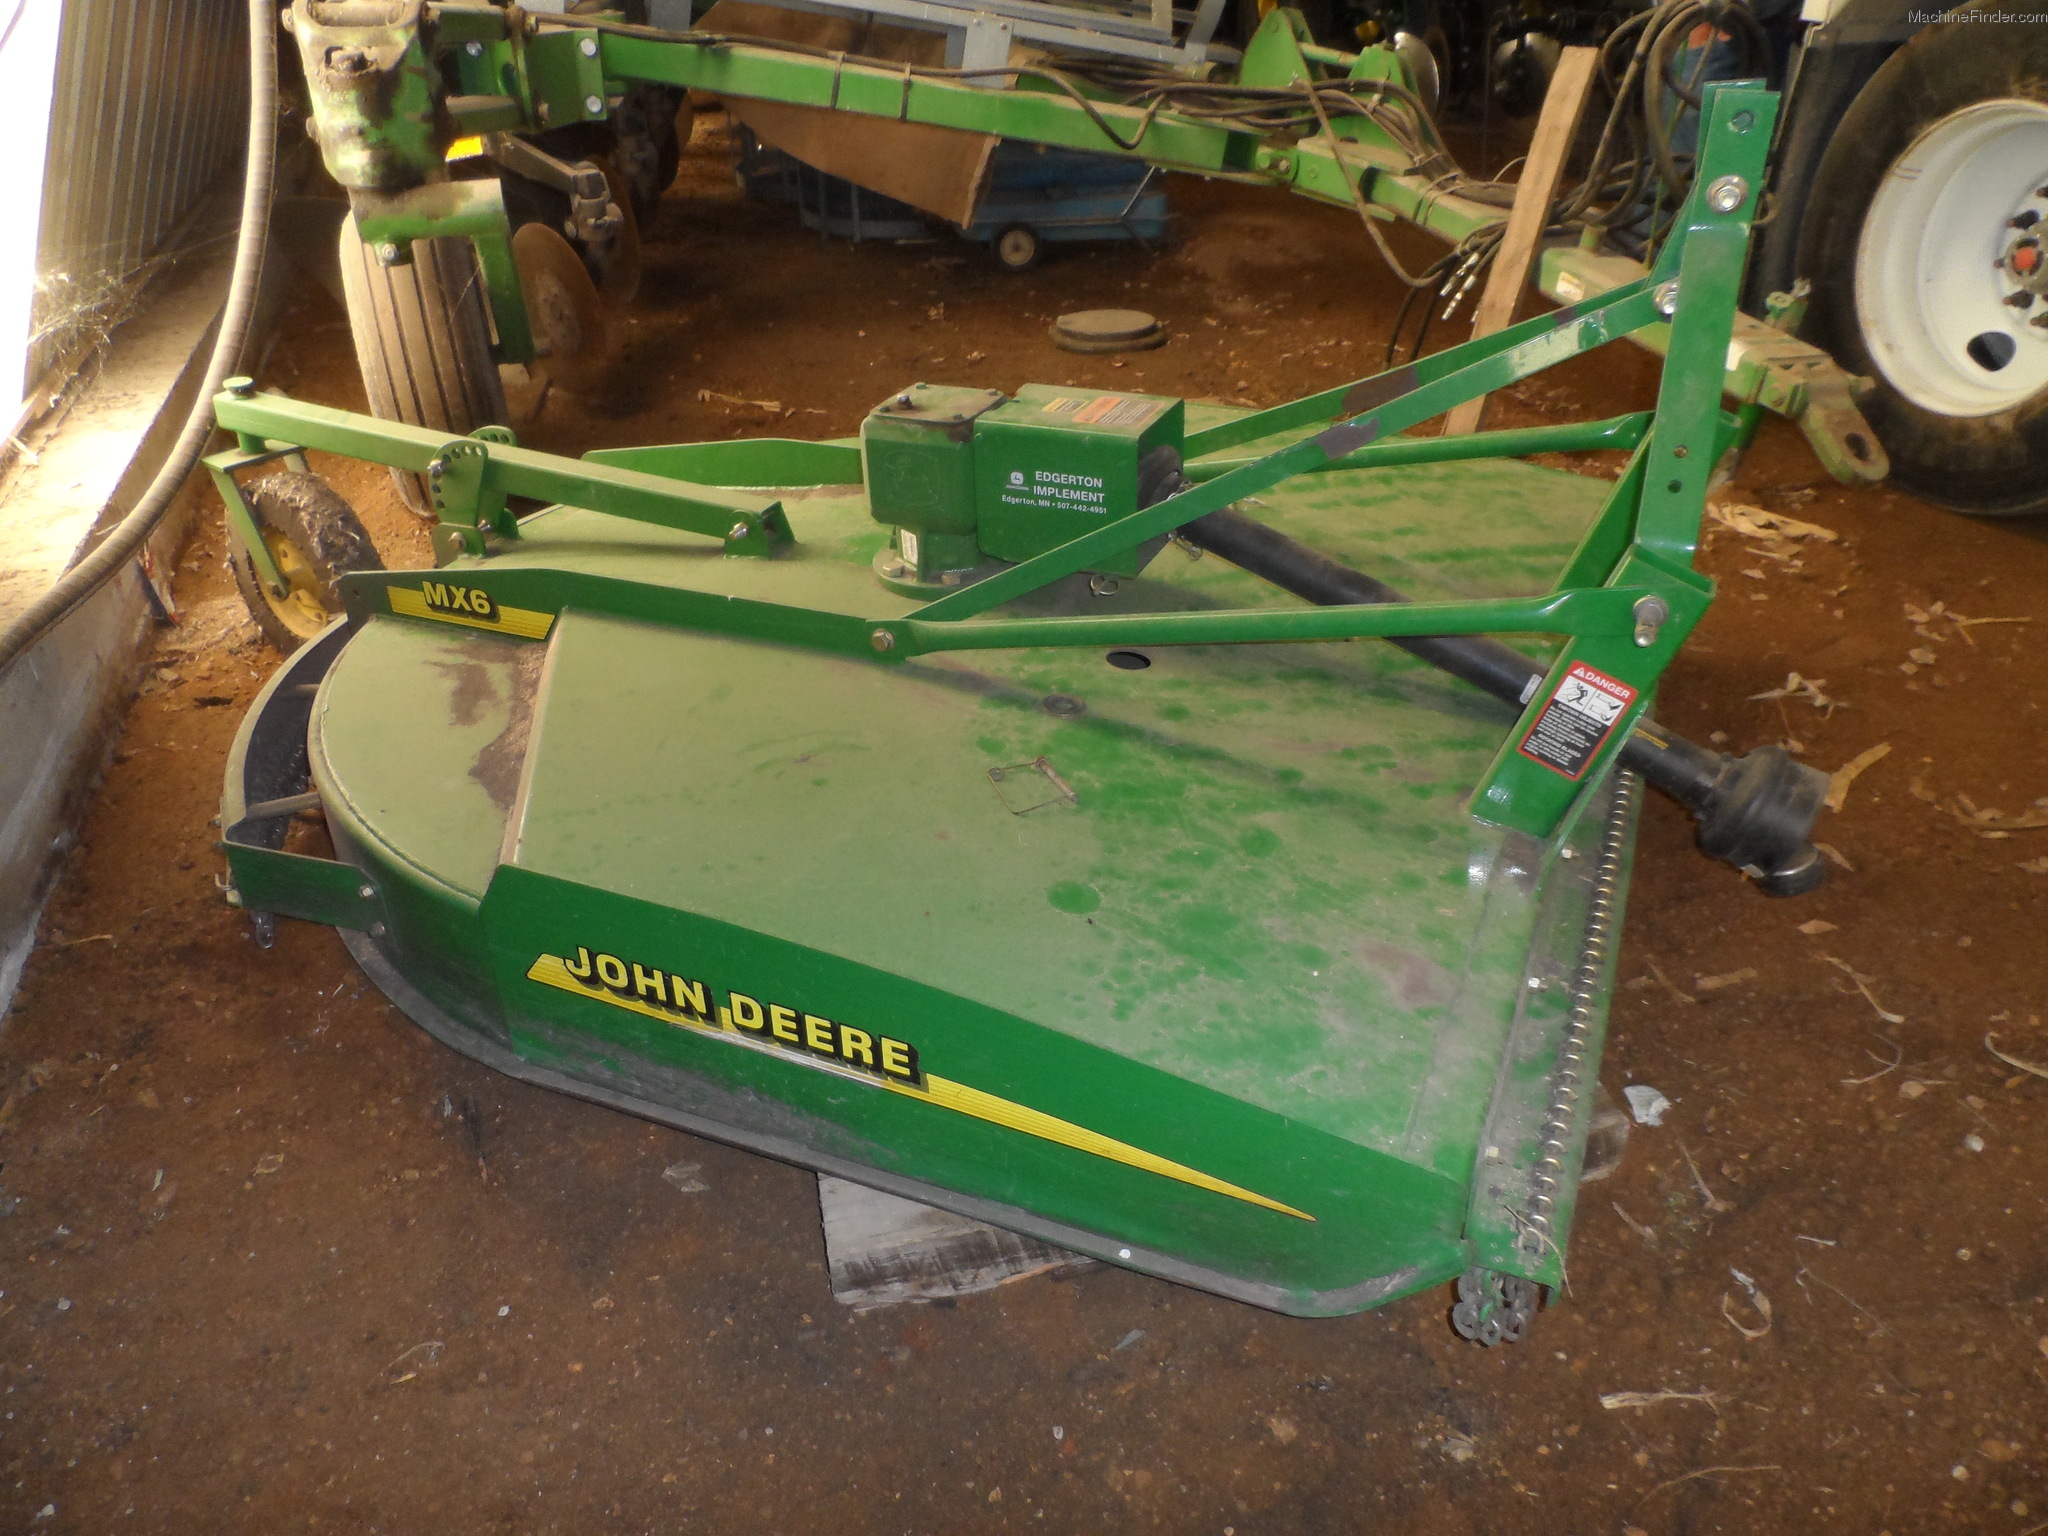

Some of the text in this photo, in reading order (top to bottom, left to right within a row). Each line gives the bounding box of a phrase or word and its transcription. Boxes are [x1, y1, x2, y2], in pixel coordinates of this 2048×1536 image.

[1035, 471, 1103, 488] EDGERTON
[1002, 494, 1037, 507] Edgerton,
[1038, 499, 1051, 508] MN
[1033, 485, 1105, 503] IMPLEMENT
[422, 580, 491, 615] MX6
[1584, 671, 1631, 699] DANGER
[564, 946, 914, 1078] JOHN DEERE
